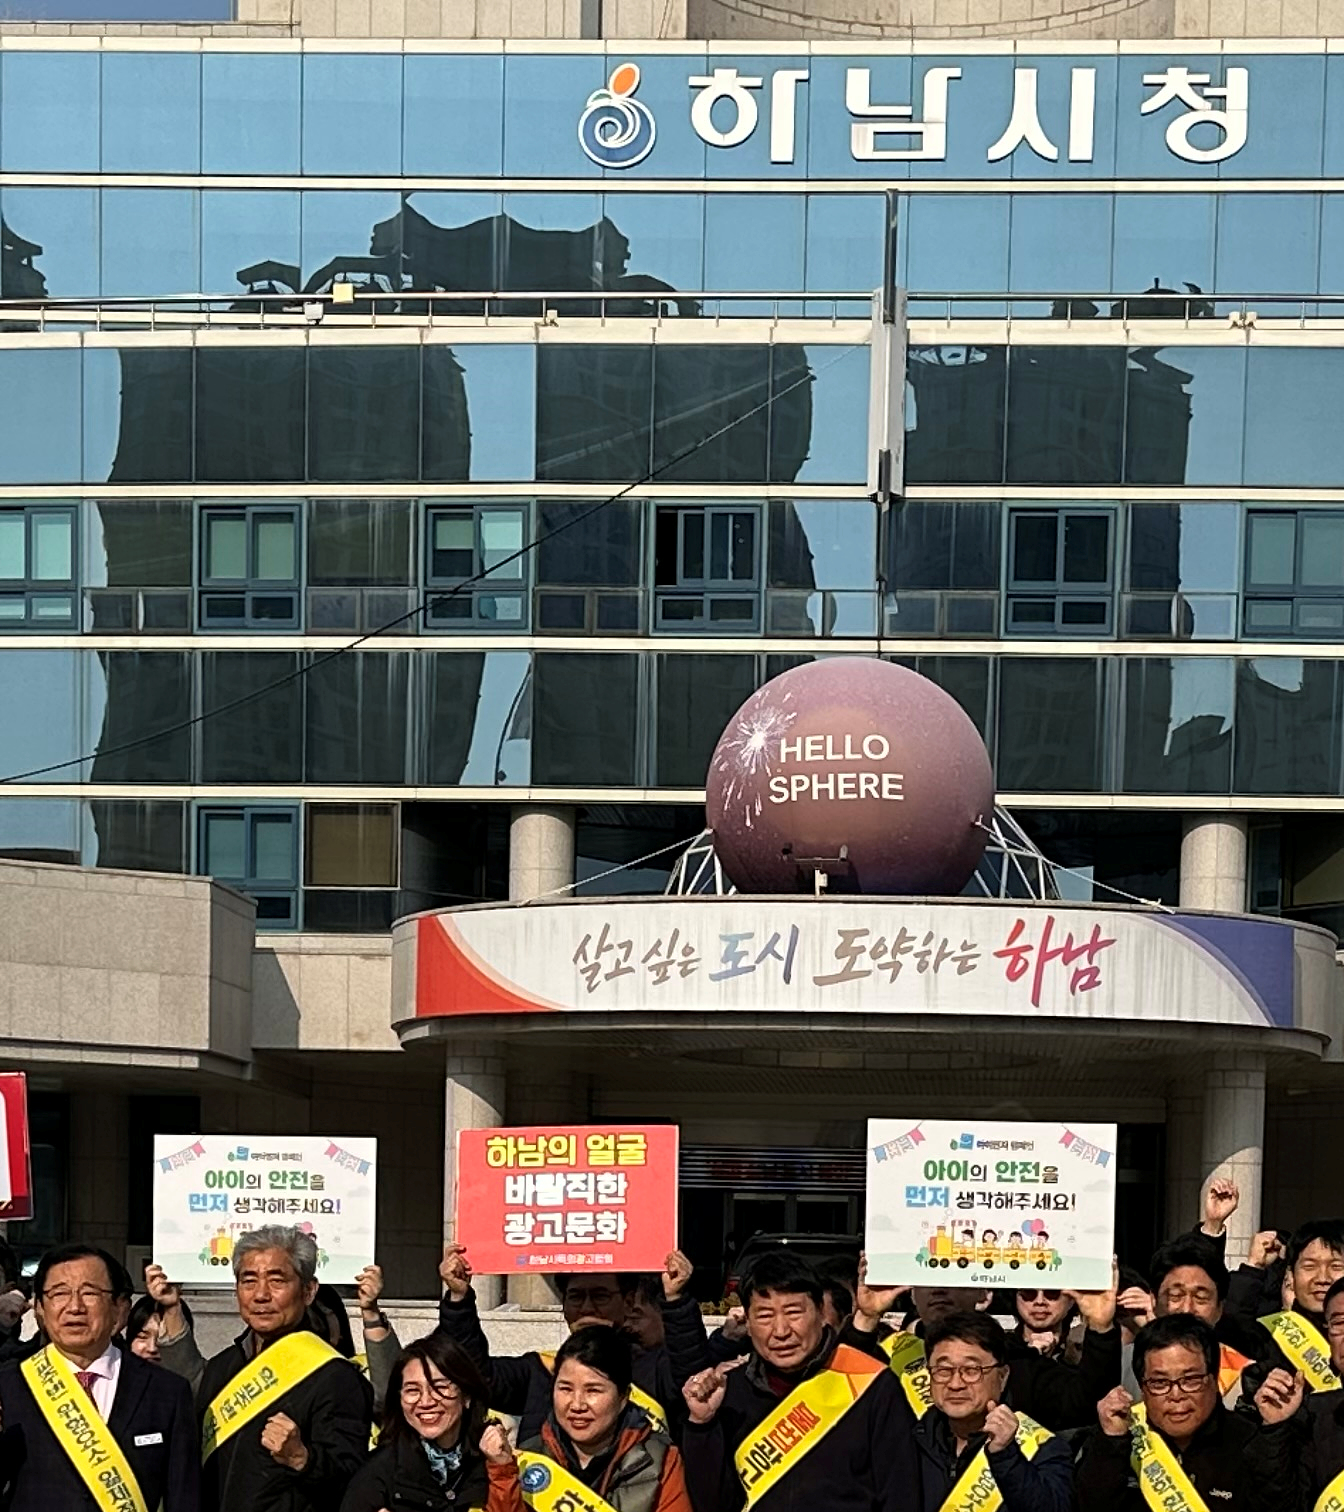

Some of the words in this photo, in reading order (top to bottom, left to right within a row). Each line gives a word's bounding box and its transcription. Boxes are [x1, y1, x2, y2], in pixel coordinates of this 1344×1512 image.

[688, 66, 1249, 164] 하남시청
[779, 734, 890, 763] HELLO
[769, 771, 905, 804] SPHERE
[706, 922, 802, 985] 도시
[811, 928, 981, 988] 도약하는
[994, 915, 1119, 1008] 하남
[486, 1134, 577, 1168] 하남의
[586, 1133, 647, 1166] 얼굴
[205, 1170, 261, 1189] 아이의
[268, 1170, 325, 1190] 안전을
[504, 1171, 628, 1206] 바람직한
[923, 1159, 987, 1182] 아이의
[995, 1160, 1059, 1184] 안전을
[188, 1193, 229, 1213] 먼저
[234, 1198, 341, 1214] 생각해주세요!
[905, 1185, 950, 1208] 먼저
[955, 1191, 1076, 1212] 생각해주세요!
[504, 1210, 628, 1245] 광고문화
[55, 1396, 110, 1469] 위험요소
